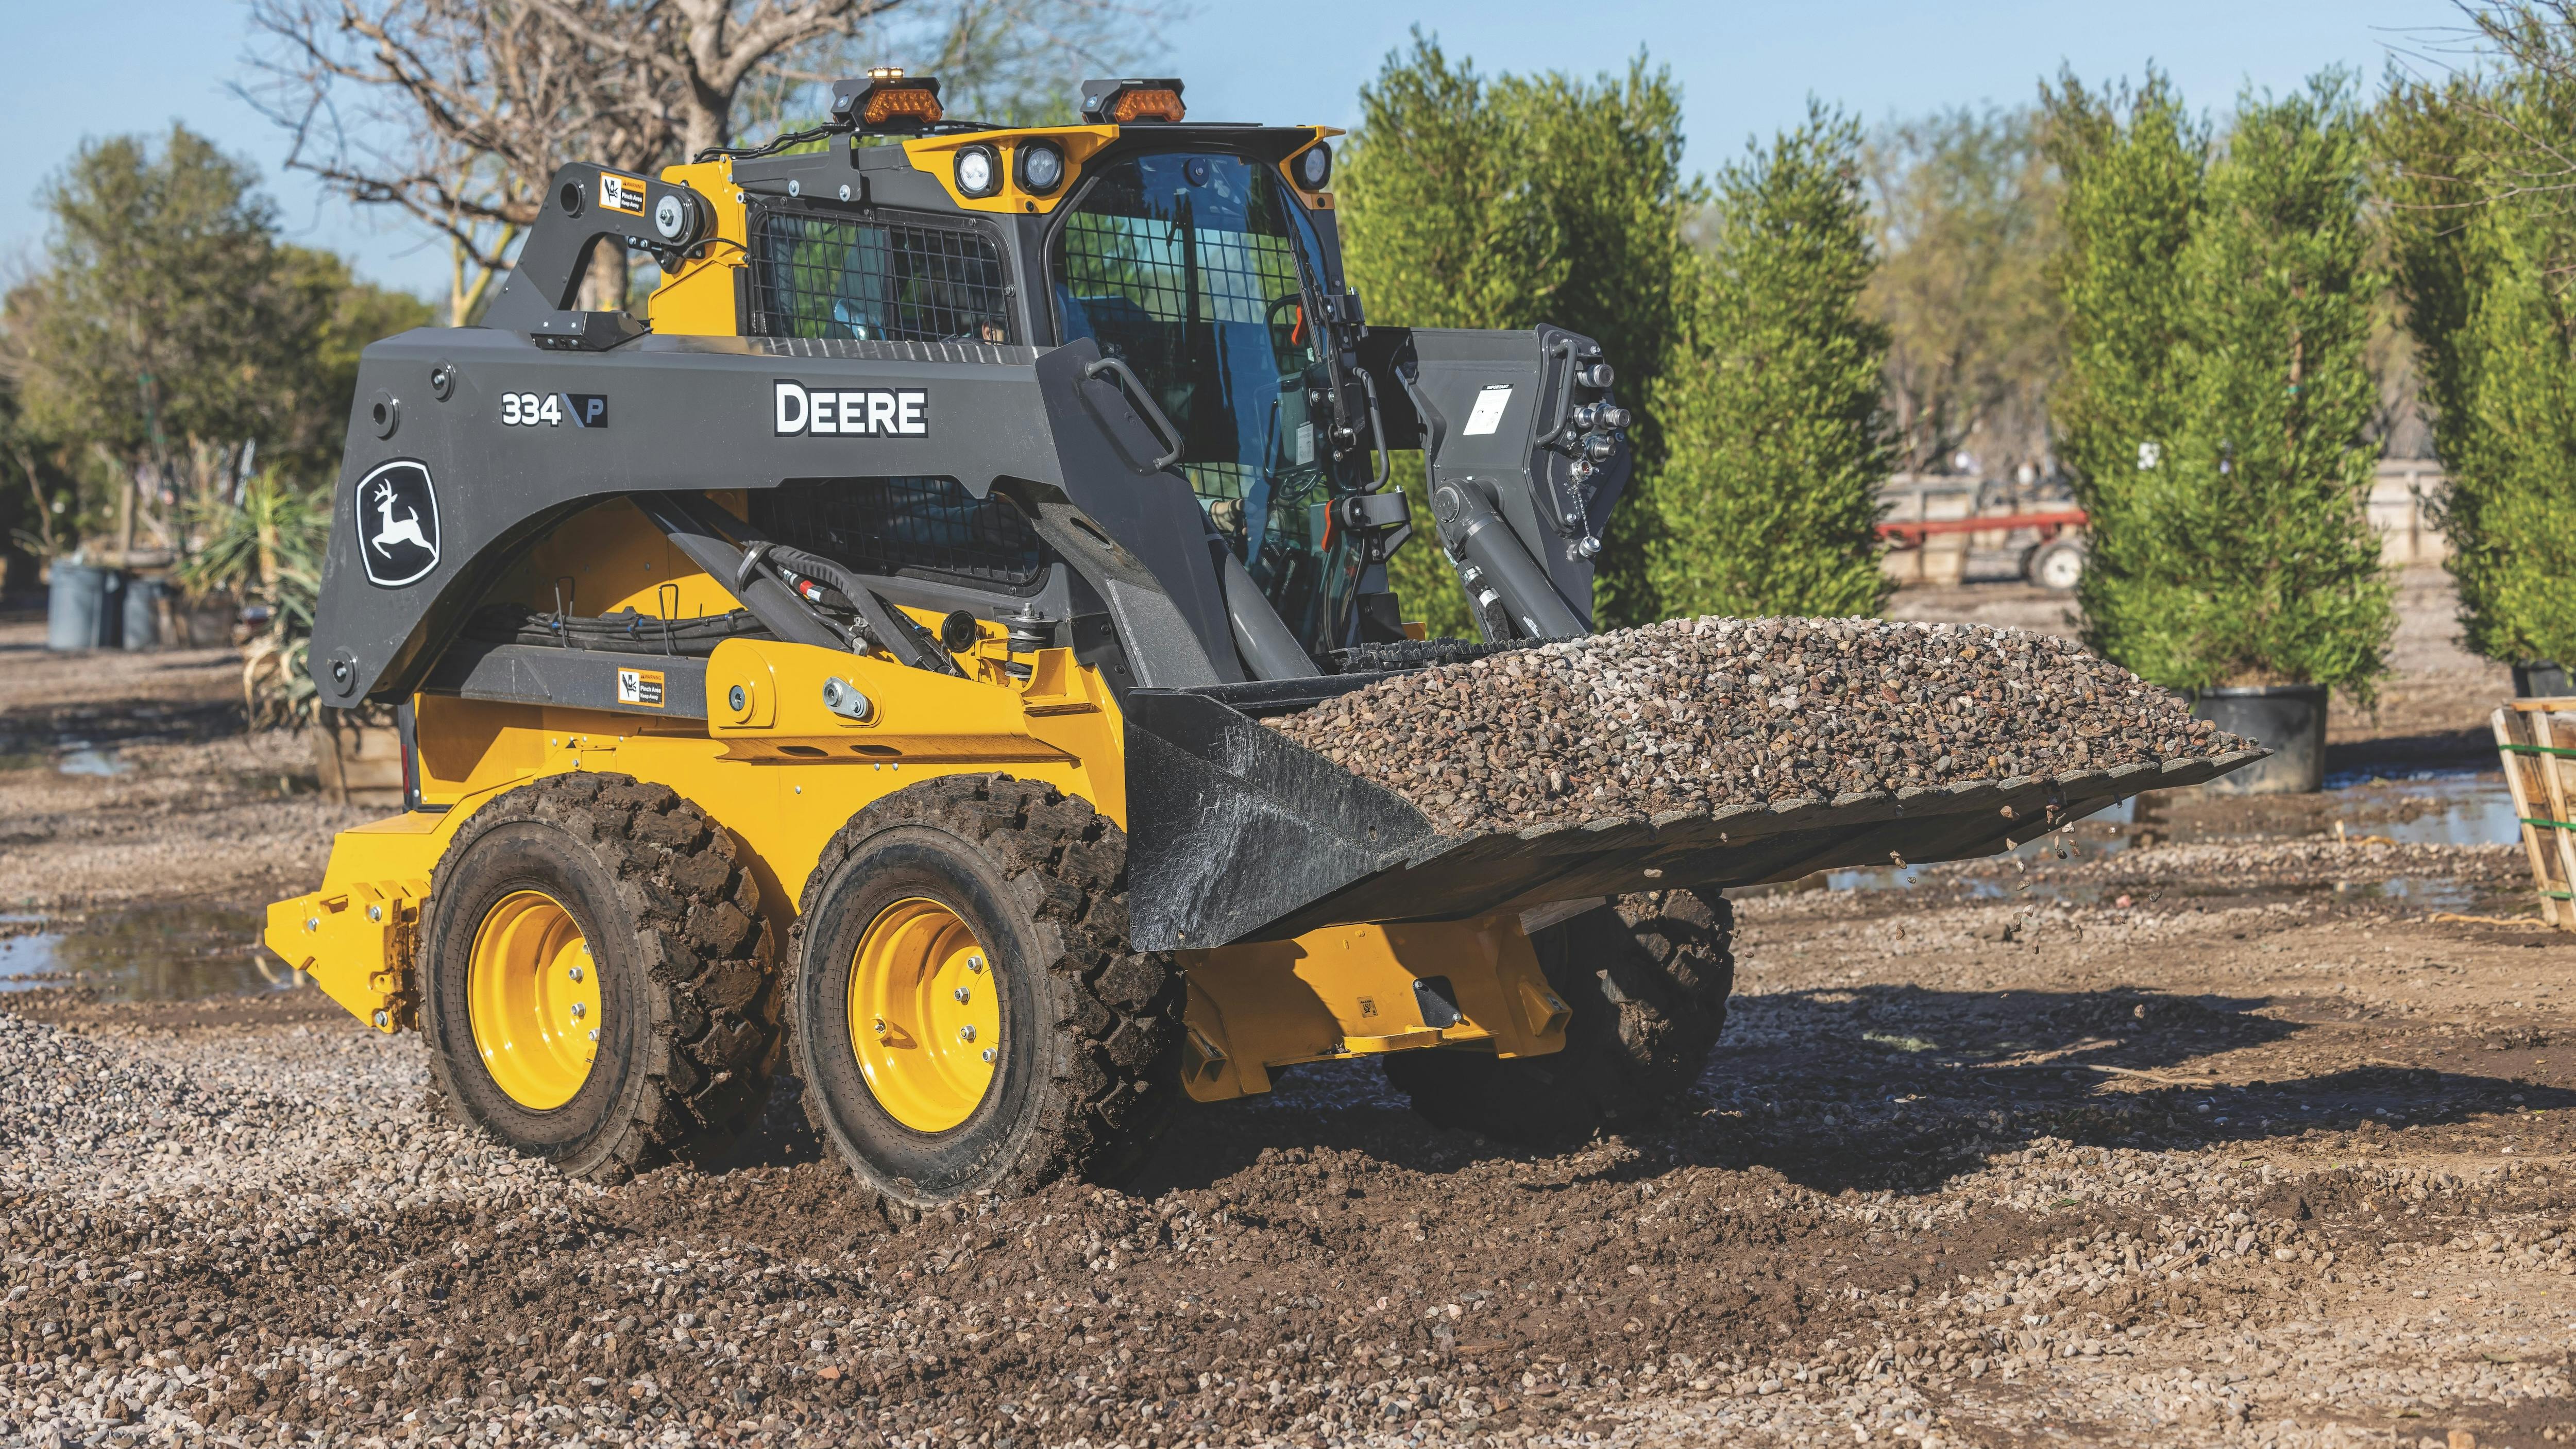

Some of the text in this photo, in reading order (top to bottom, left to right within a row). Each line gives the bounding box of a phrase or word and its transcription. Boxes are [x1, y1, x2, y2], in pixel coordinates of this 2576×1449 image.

[621, 192, 633, 200] Pinch
[502, 393, 604, 426] 334 P
[775, 383, 926, 434] DEERE
[836, 828, 929, 881] GALAXY
[575, 1104, 627, 1167] GALAXY
